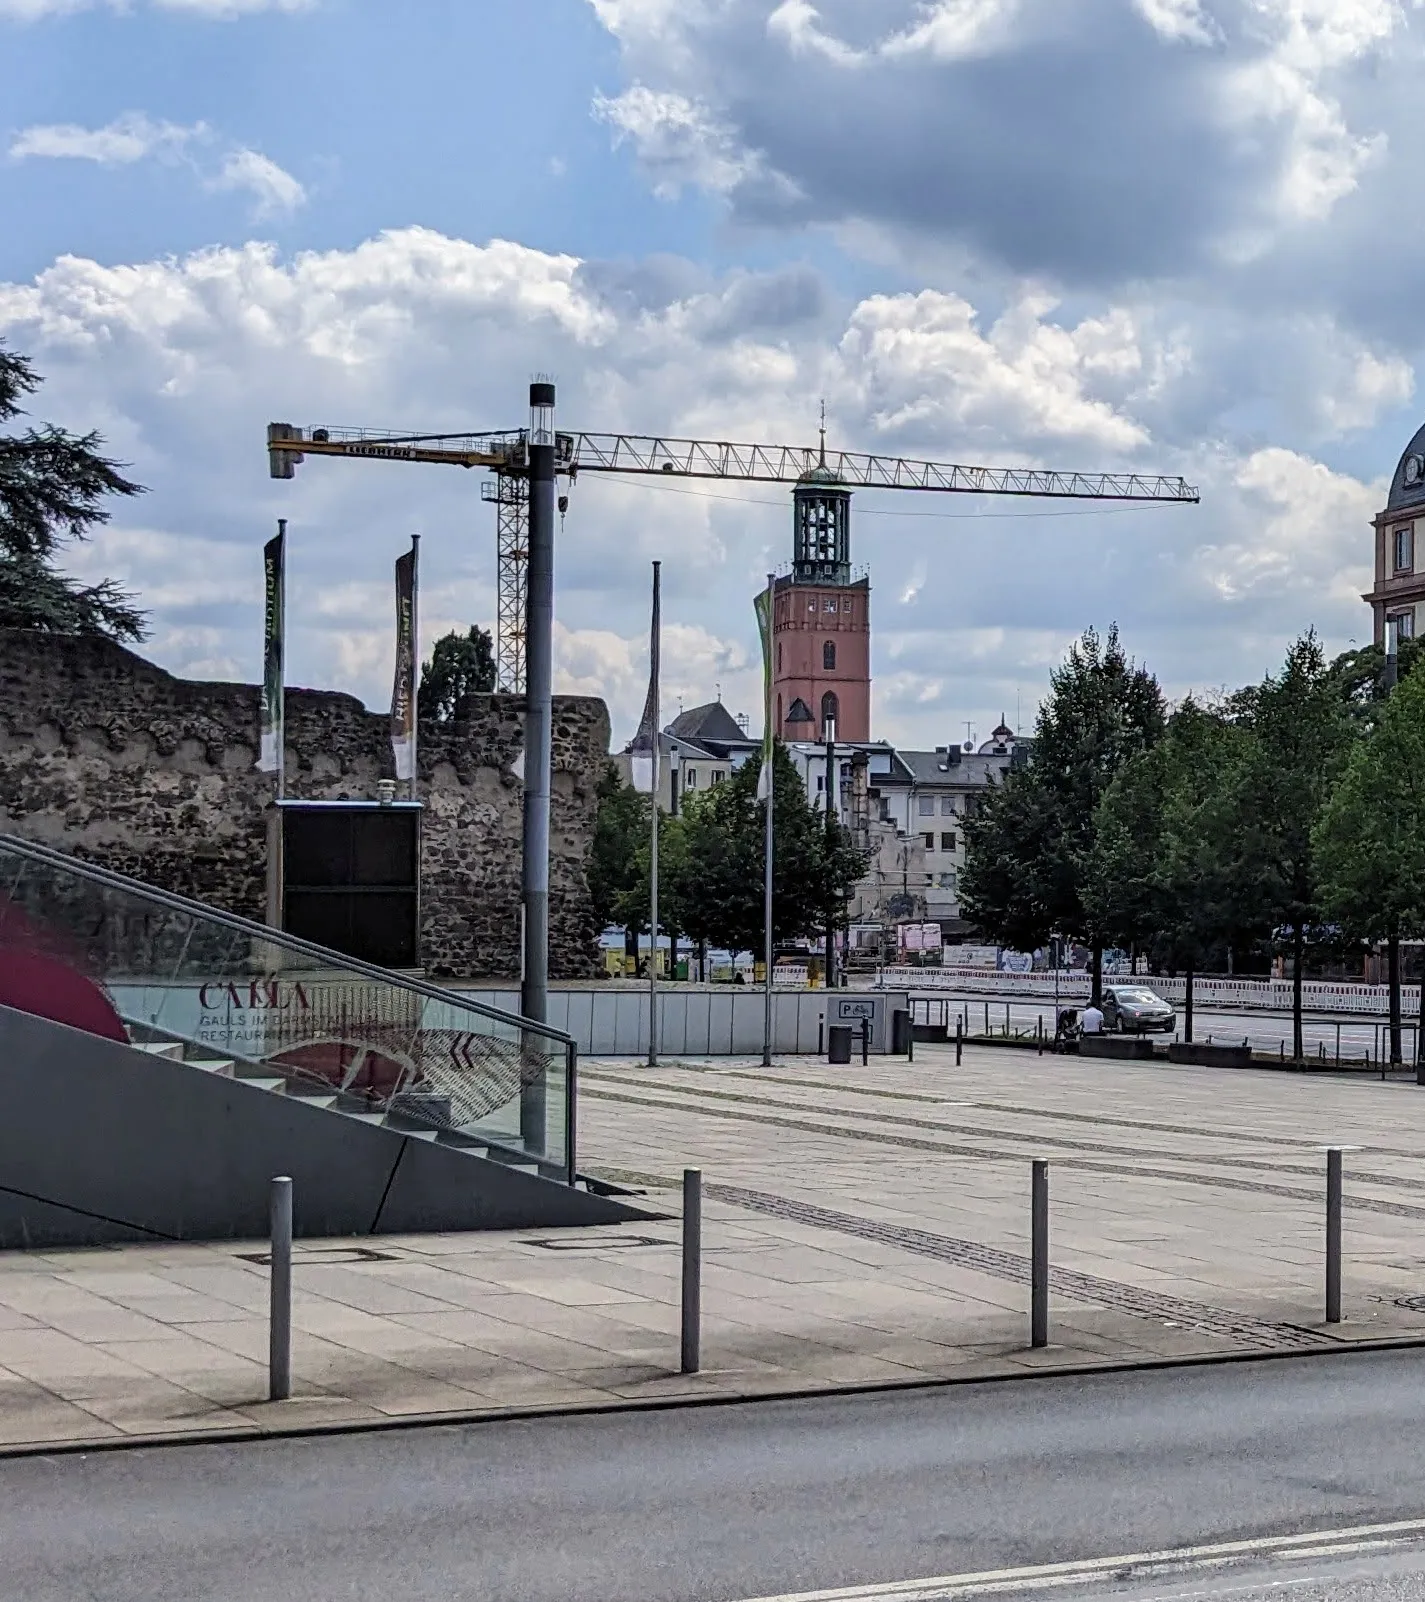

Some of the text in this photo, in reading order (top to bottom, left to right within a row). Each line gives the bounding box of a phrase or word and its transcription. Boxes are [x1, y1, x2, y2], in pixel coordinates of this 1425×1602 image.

[843, 1004, 851, 1015] P
[200, 1015, 246, 1026] GAULS
[201, 1030, 284, 1041] RESTAURA
